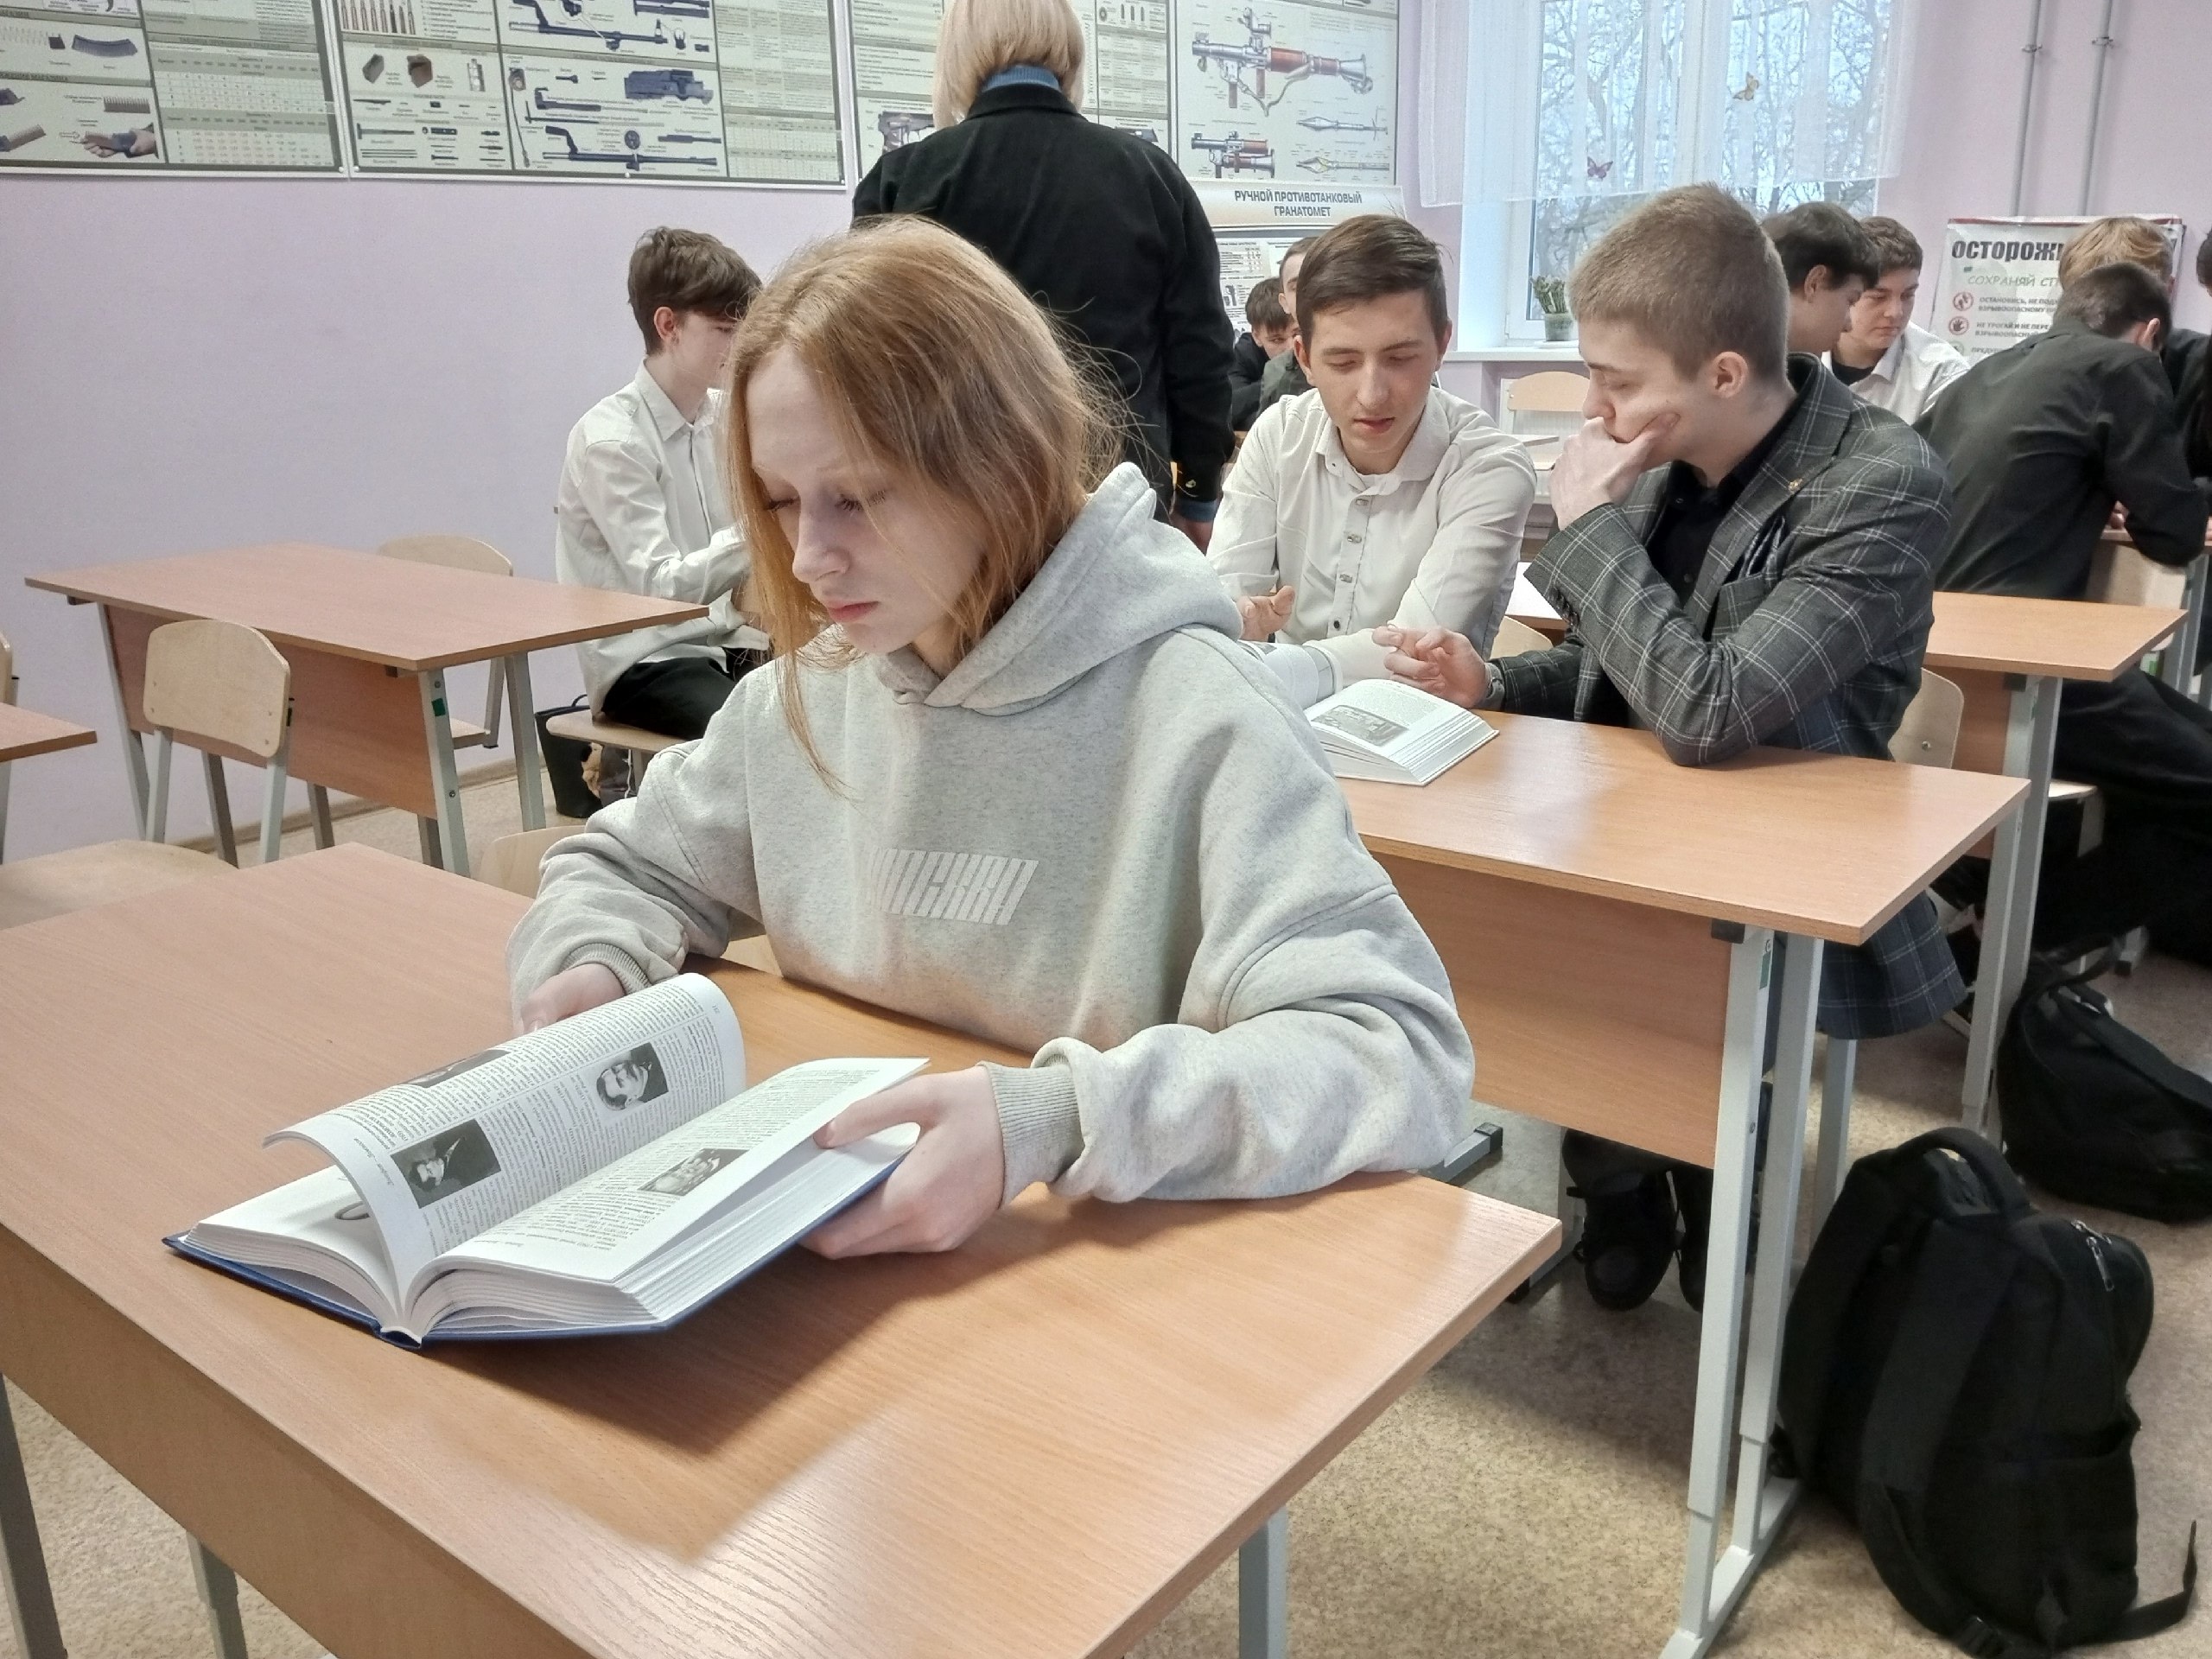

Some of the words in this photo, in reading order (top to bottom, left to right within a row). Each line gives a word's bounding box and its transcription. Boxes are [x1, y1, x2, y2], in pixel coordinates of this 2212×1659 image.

[1234, 189, 1274, 203] РУЧНОЙ
[1274, 190, 1363, 204] ПРОТИВОТАНКОВЫЙ
[1274, 206, 1332, 217] ГРАНАТОМЕТ
[1967, 274, 2036, 287] СОХРАНЯЙ
[2040, 277, 2059, 287] СТ
